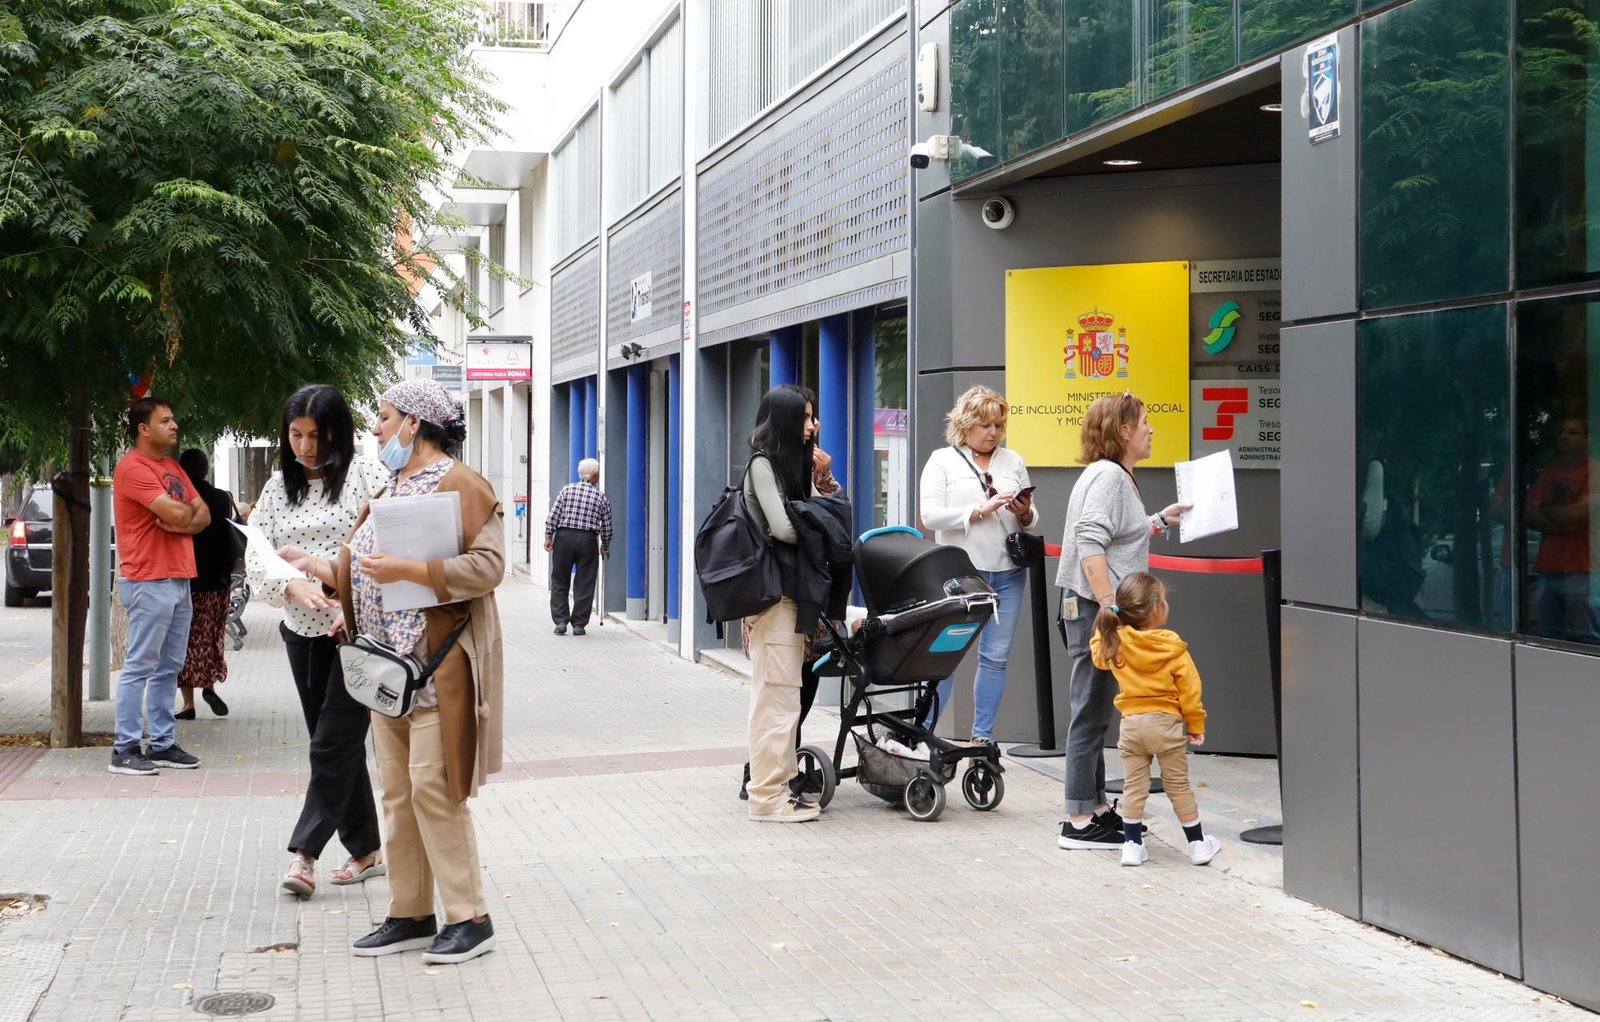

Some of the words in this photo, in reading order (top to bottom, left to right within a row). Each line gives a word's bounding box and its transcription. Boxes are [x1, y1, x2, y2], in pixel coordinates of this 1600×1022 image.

[1199, 270, 1243, 283] SECRETARIA
[1244, 269, 1254, 281] DE
[1256, 268, 1282, 281] ESTAD
[1258, 311, 1281, 321] SEG
[1257, 344, 1280, 354] SEG
[1237, 364, 1270, 373] CAISS
[1010, 405, 1023, 415] DE
[1026, 402, 1084, 416] INCLUSIÓN,
[1147, 403, 1184, 414] SOCIAL
[1056, 417, 1063, 426] Y
